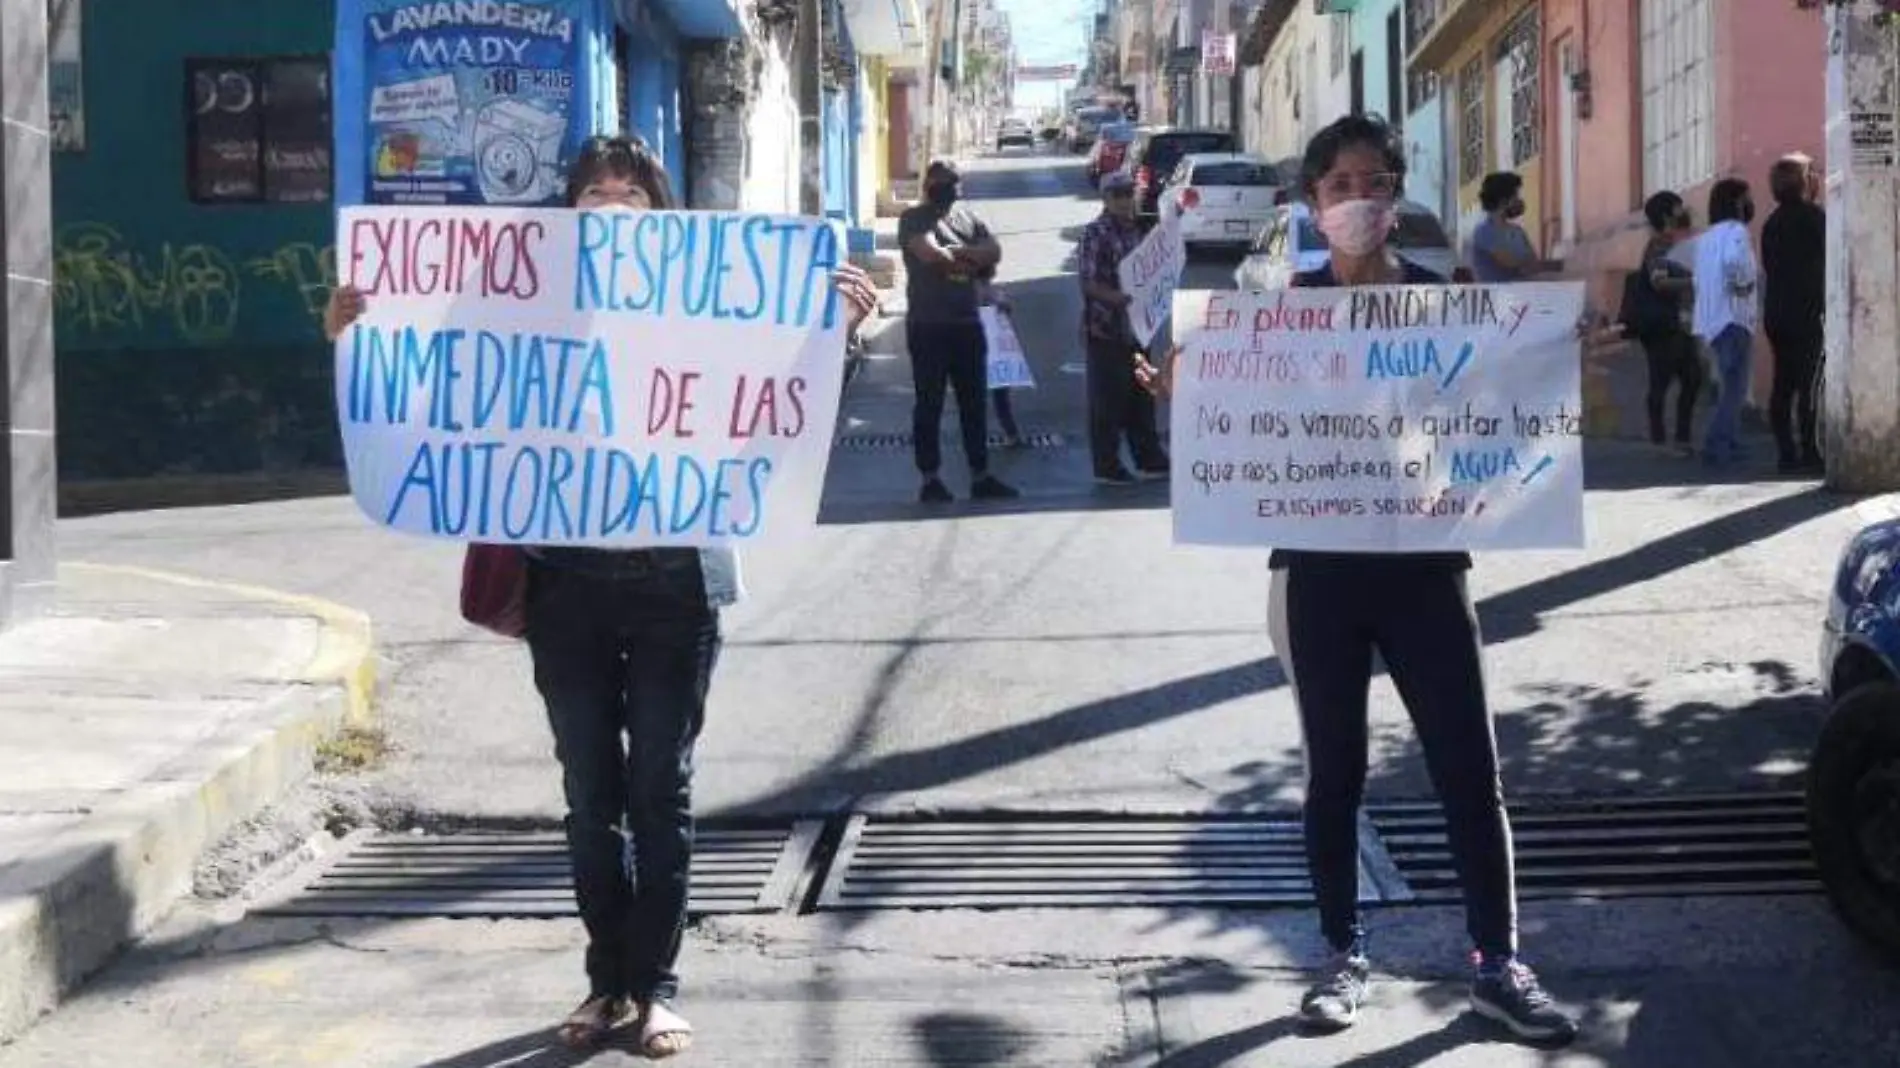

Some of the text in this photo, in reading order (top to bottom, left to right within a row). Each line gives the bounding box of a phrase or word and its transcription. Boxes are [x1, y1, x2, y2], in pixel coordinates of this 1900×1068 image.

[369, 1, 571, 43] LAVANDERIA
[407, 36, 531, 65] MADY
[351, 218, 543, 299] EXIGIMOS
[575, 212, 837, 329] RESPUESTA
[1204, 296, 1240, 331] En
[1252, 291, 1335, 349] plena
[349, 324, 807, 438] INMEDIATA DE LAS
[1197, 402, 1584, 450] No nos vamos a quitar hasta
[386, 442, 773, 539] AUTORIDADES
[1191, 458, 1235, 495] que
[1241, 460, 1280, 484] nos
[1405, 452, 1431, 481] el
[1257, 497, 1366, 518] EXIGIMOS
